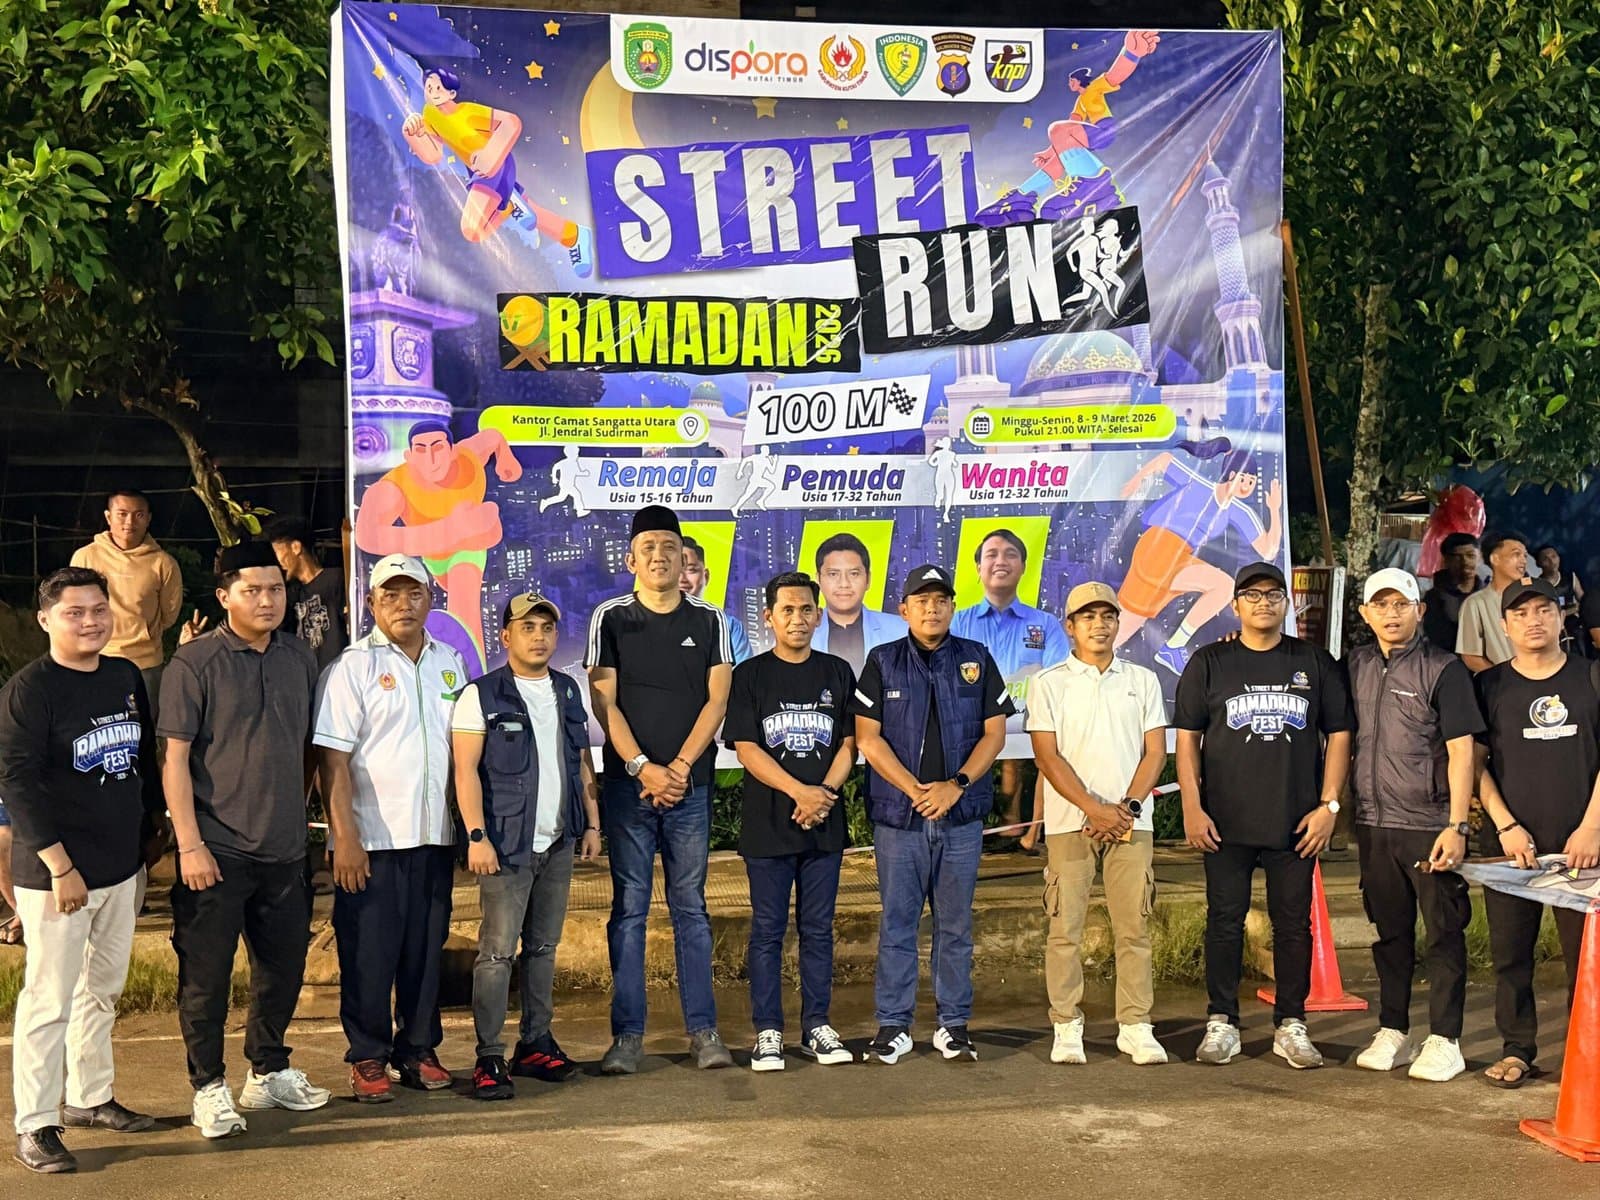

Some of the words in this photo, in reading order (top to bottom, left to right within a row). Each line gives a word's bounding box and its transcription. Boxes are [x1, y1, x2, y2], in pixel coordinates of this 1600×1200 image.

[880, 34, 924, 47] INDONESIA
[685, 42, 808, 80] dispora
[991, 54, 1028, 91] knpi
[614, 132, 972, 262] STREET
[878, 223, 1060, 338] RUN
[548, 297, 808, 367] RAMADAN
[815, 304, 842, 364] 2026
[512, 415, 551, 425] Kantor
[553, 416, 590, 426] Camat
[592, 417, 642, 429] Sangatta
[644, 417, 676, 427] Utara
[758, 391, 836, 435] 100
[846, 387, 887, 429] M
[1077, 415, 1084, 423] 8
[1101, 413, 1129, 423] Maret
[1132, 413, 1157, 422] 2026
[539, 427, 550, 437] Jl.
[553, 427, 593, 438] Jendral
[595, 426, 649, 437] Sudirman
[1014, 426, 1045, 436] Pukul
[1047, 425, 1075, 435] 21.00
[598, 459, 717, 494] Remaja
[781, 462, 906, 491] Pemuda
[962, 460, 1069, 489] Wanita
[609, 492, 636, 503] Usia
[640, 492, 672, 503] 15-16
[676, 492, 713, 503] Tahun
[802, 491, 828, 502] Usia
[832, 491, 863, 502] 17-32
[866, 491, 902, 502] Tahun
[969, 489, 995, 500] Usia
[999, 488, 1030, 499] 12-32
[1034, 487, 1069, 498] Tahun
[1228, 693, 1307, 717] RAMADHAN
[765, 712, 832, 735] RAMADHAN
[1252, 715, 1284, 730] FEST
[787, 732, 814, 746] FEST
[103, 748, 130, 769] FEST
